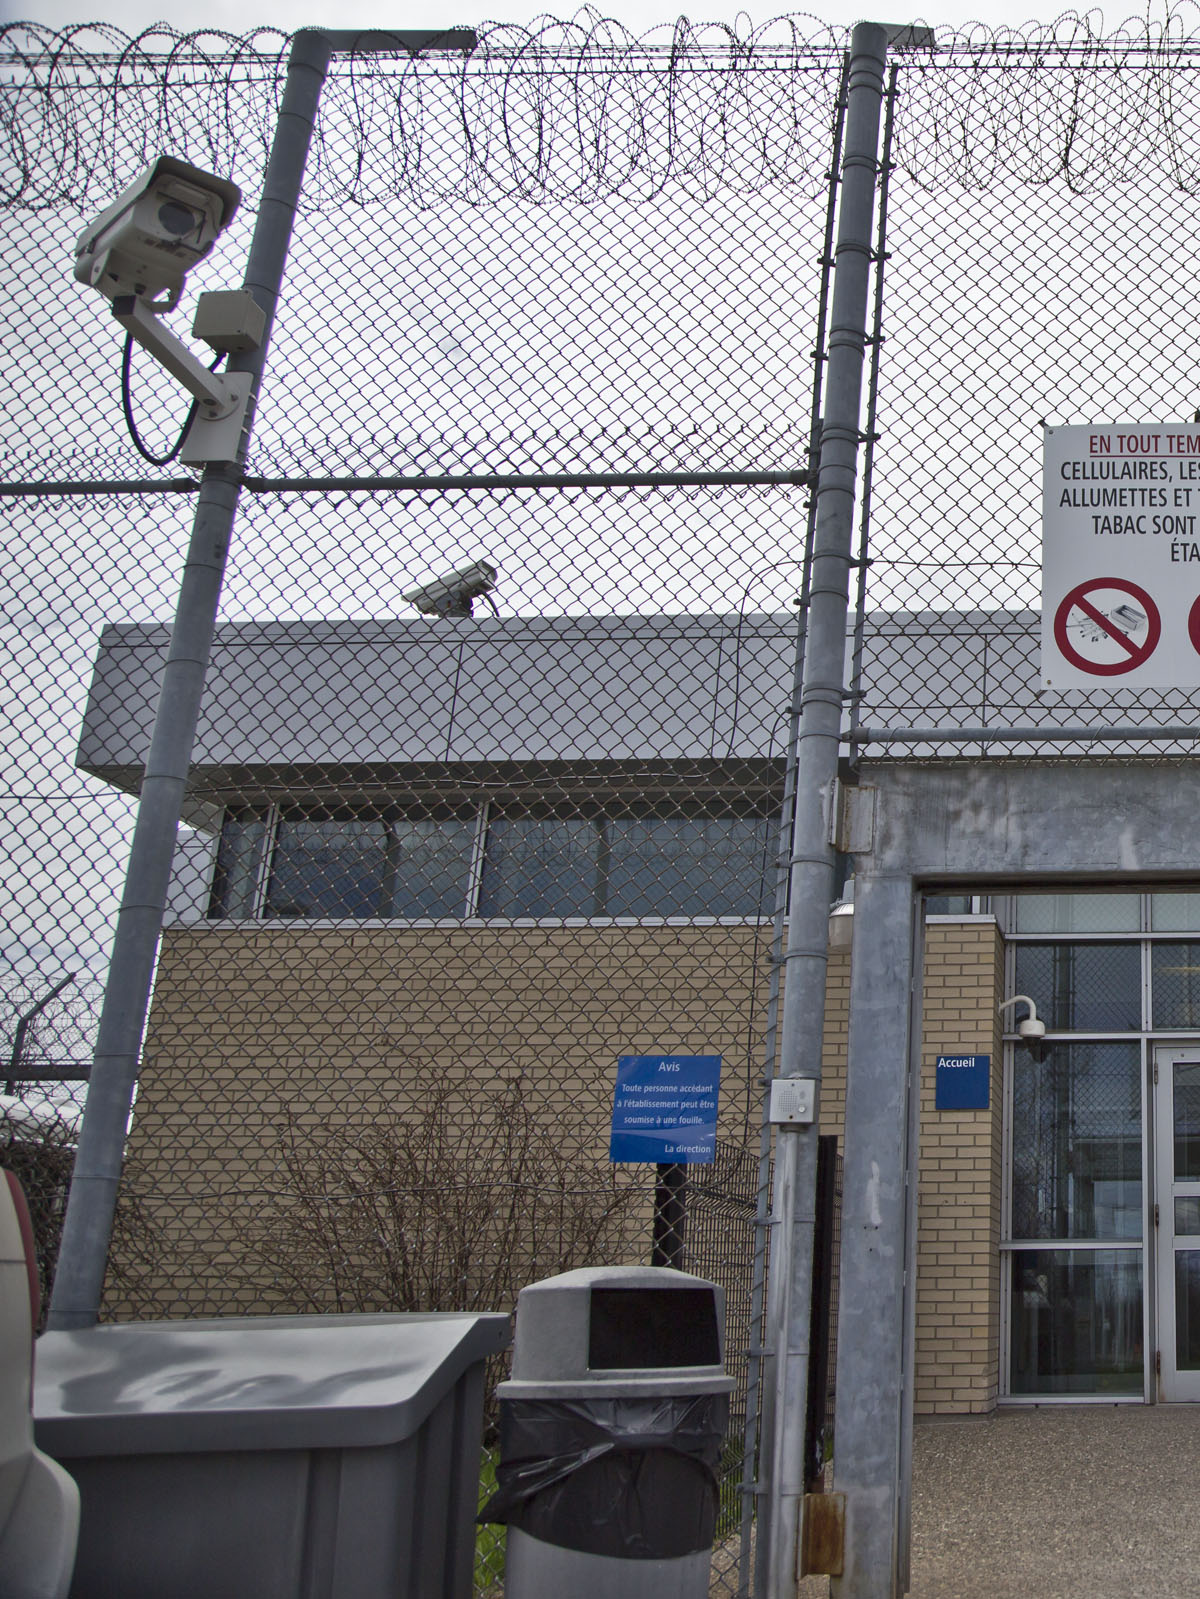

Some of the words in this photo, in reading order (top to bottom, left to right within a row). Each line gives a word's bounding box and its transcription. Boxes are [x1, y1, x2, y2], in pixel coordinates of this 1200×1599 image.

[1089, 434, 1111, 454] EN
[1117, 434, 1161, 454] TOUT
[1060, 461, 1173, 483] CELLULAIRES,
[1059, 488, 1168, 507] ALLUMETTES
[1173, 488, 1193, 507] ET
[1091, 515, 1147, 534] TABAC
[1152, 515, 1197, 535] SONT
[658, 1061, 681, 1072] Avis
[938, 1057, 975, 1068] Accueil
[622, 1083, 643, 1092] Toute
[643, 1084, 678, 1094] personne
[679, 1083, 713, 1092] accédant
[680, 1100, 698, 1110] peut
[699, 1099, 715, 1108] être
[624, 1115, 655, 1124] soumise
[678, 1115, 704, 1124] fouille.
[664, 1144, 674, 1153] La
[675, 1143, 711, 1153] direction
